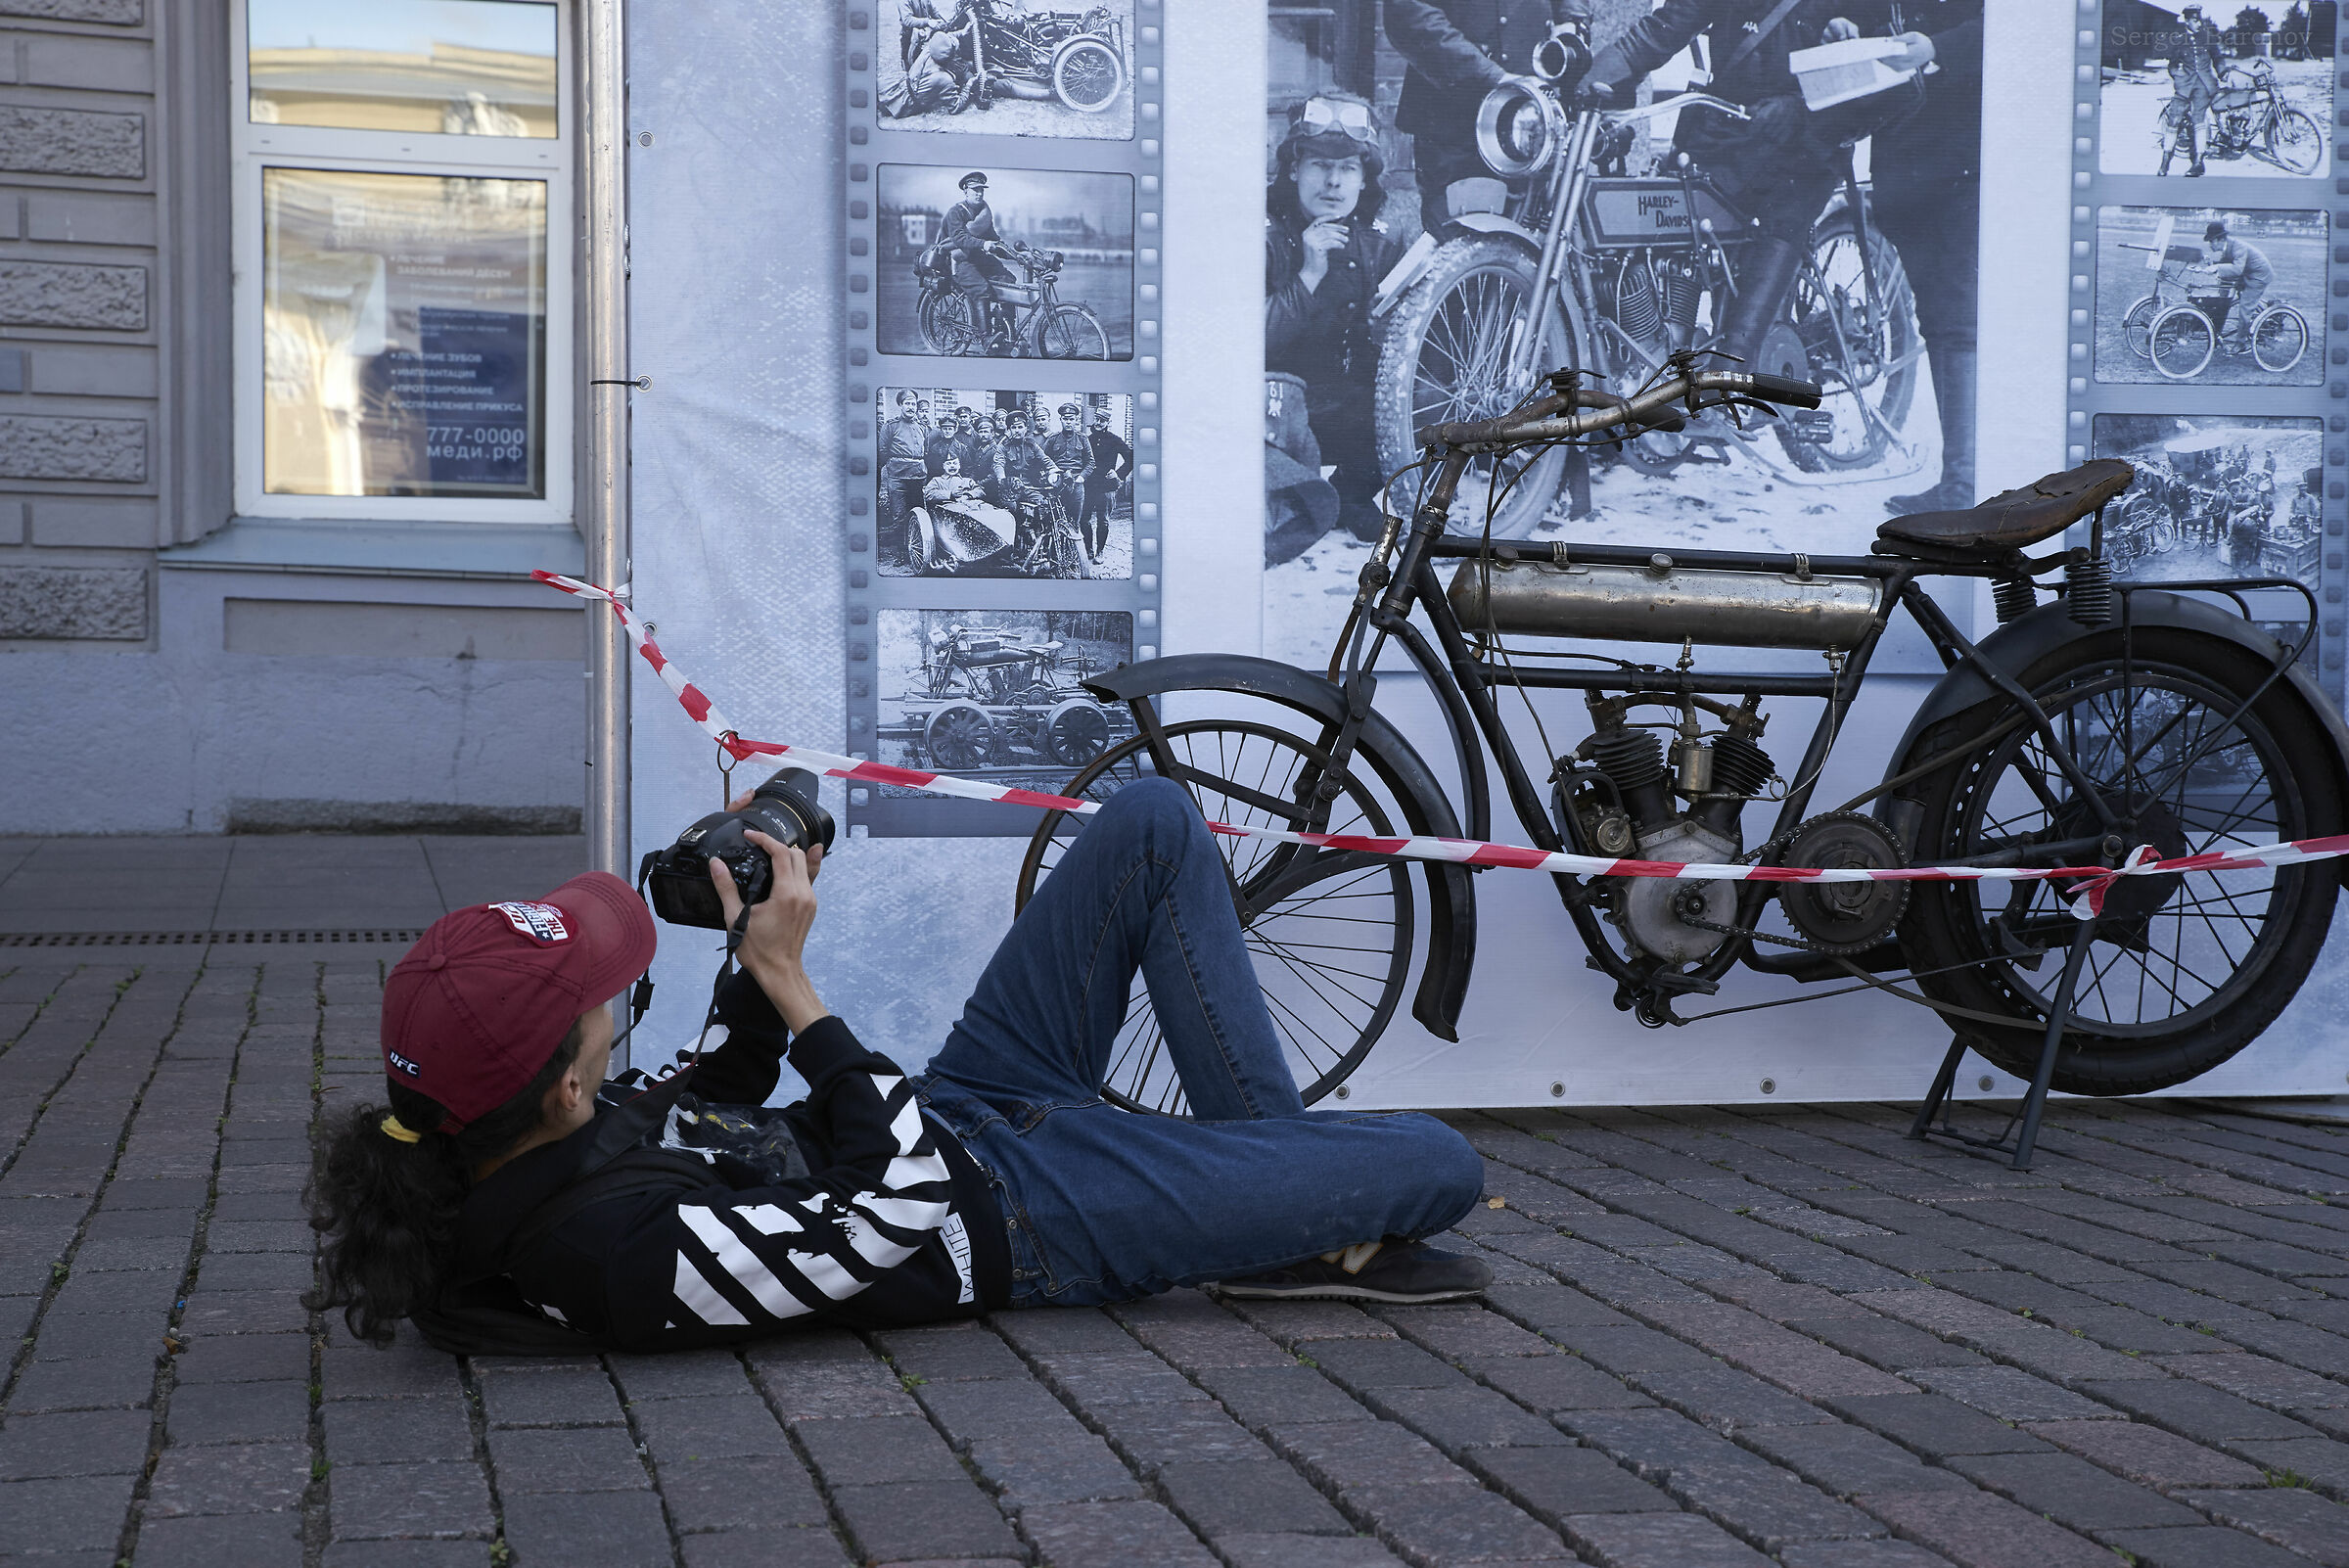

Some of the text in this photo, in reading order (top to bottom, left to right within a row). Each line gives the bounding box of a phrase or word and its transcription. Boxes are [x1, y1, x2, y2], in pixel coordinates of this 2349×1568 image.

[447, 353, 483, 363] ЗУБОВ
[426, 426, 526, 444] 777-0000
[426, 445, 524, 462] меди.рф
[390, 1051, 420, 1075] UFC
[942, 1218, 974, 1298] WHITE
